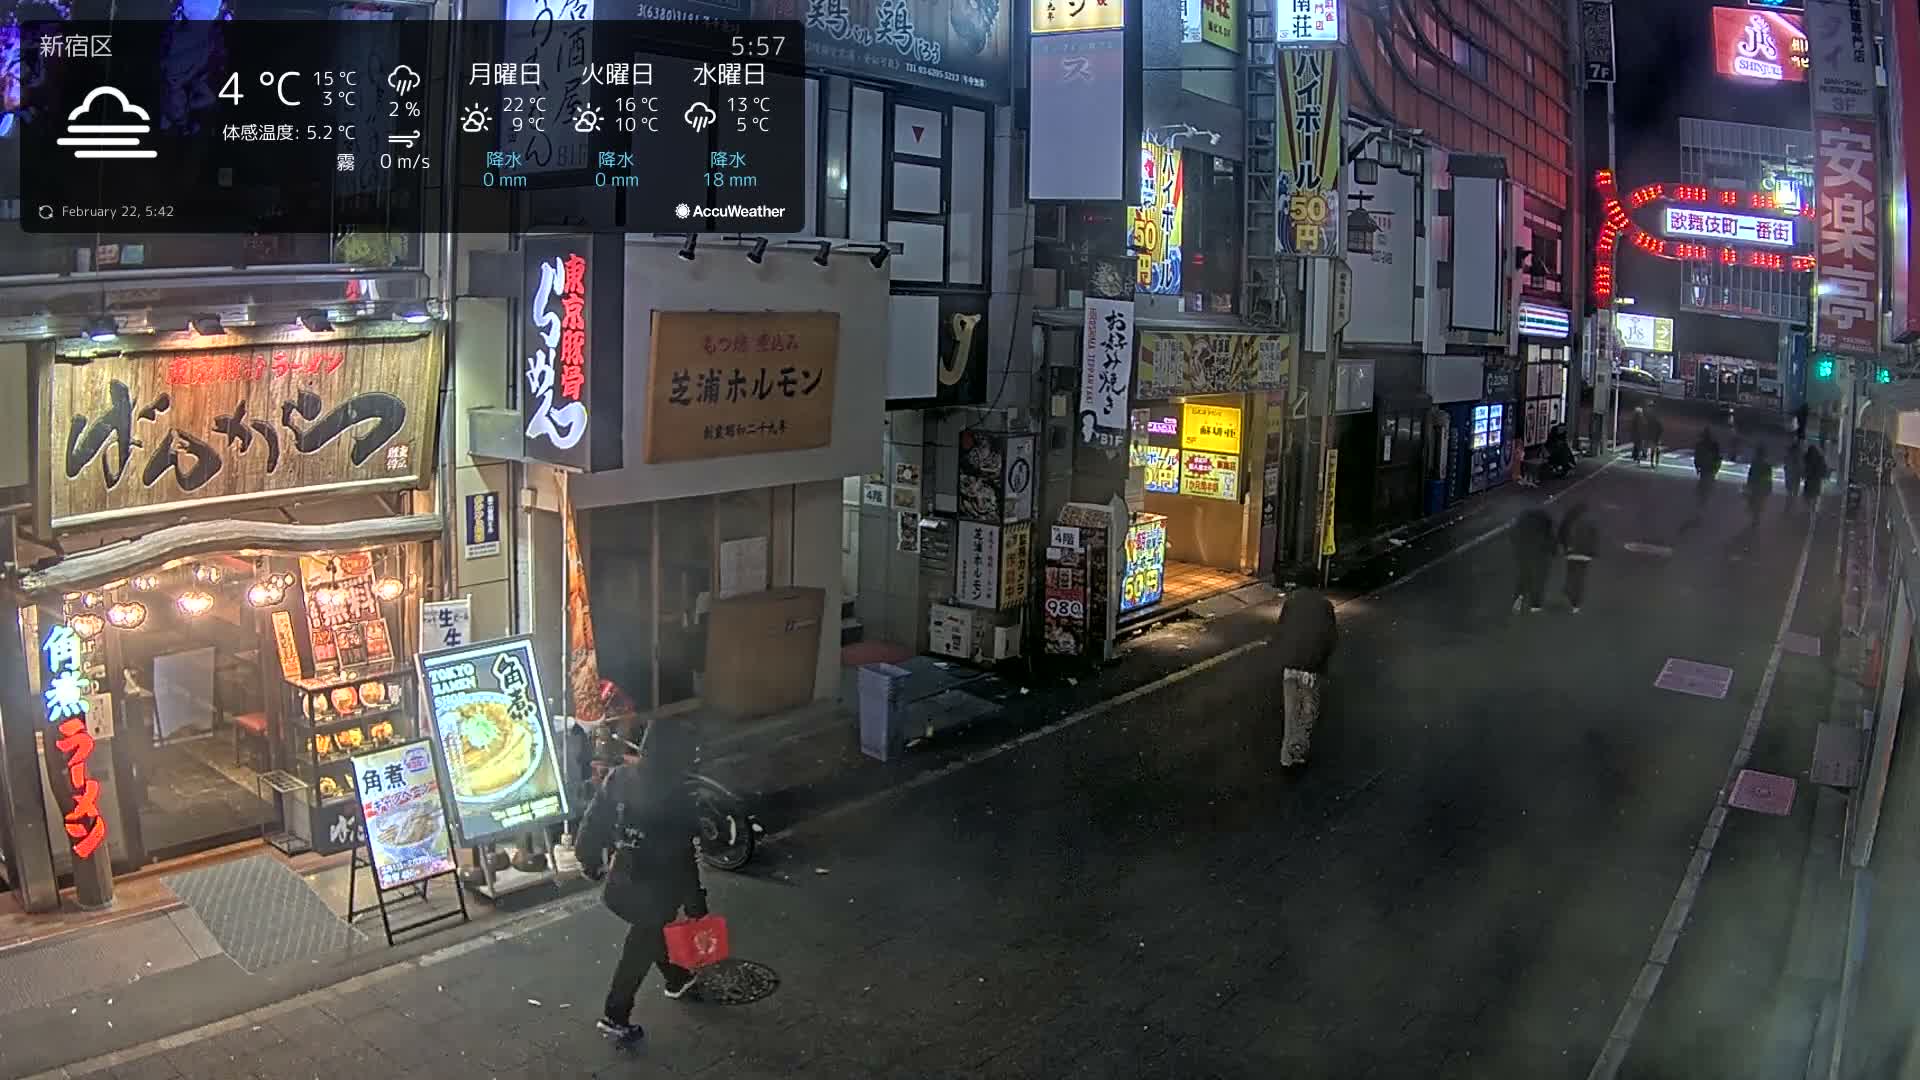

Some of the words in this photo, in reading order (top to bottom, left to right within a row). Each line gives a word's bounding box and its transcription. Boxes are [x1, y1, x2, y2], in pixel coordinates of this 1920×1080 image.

[1590, 63, 1609, 79] 7F
[1295, 54, 1323, 191] ハイボール
[1162, 153, 1175, 289] ハイボール
[1670, 211, 1790, 241] 歌舞伎町一番街
[1819, 127, 1876, 330] 安楽亭
[560, 252, 587, 401] 東京豚骨
[668, 367, 824, 407] 芝浦ホルモン
[1101, 309, 1128, 415] お好み焼き
[1054, 530, 1075, 546] 4階
[1046, 599, 1084, 618] 980
[498, 654, 534, 721] 角煮
[43, 624, 107, 858] 角煮ラーメン
[362, 764, 407, 795] 角煮
